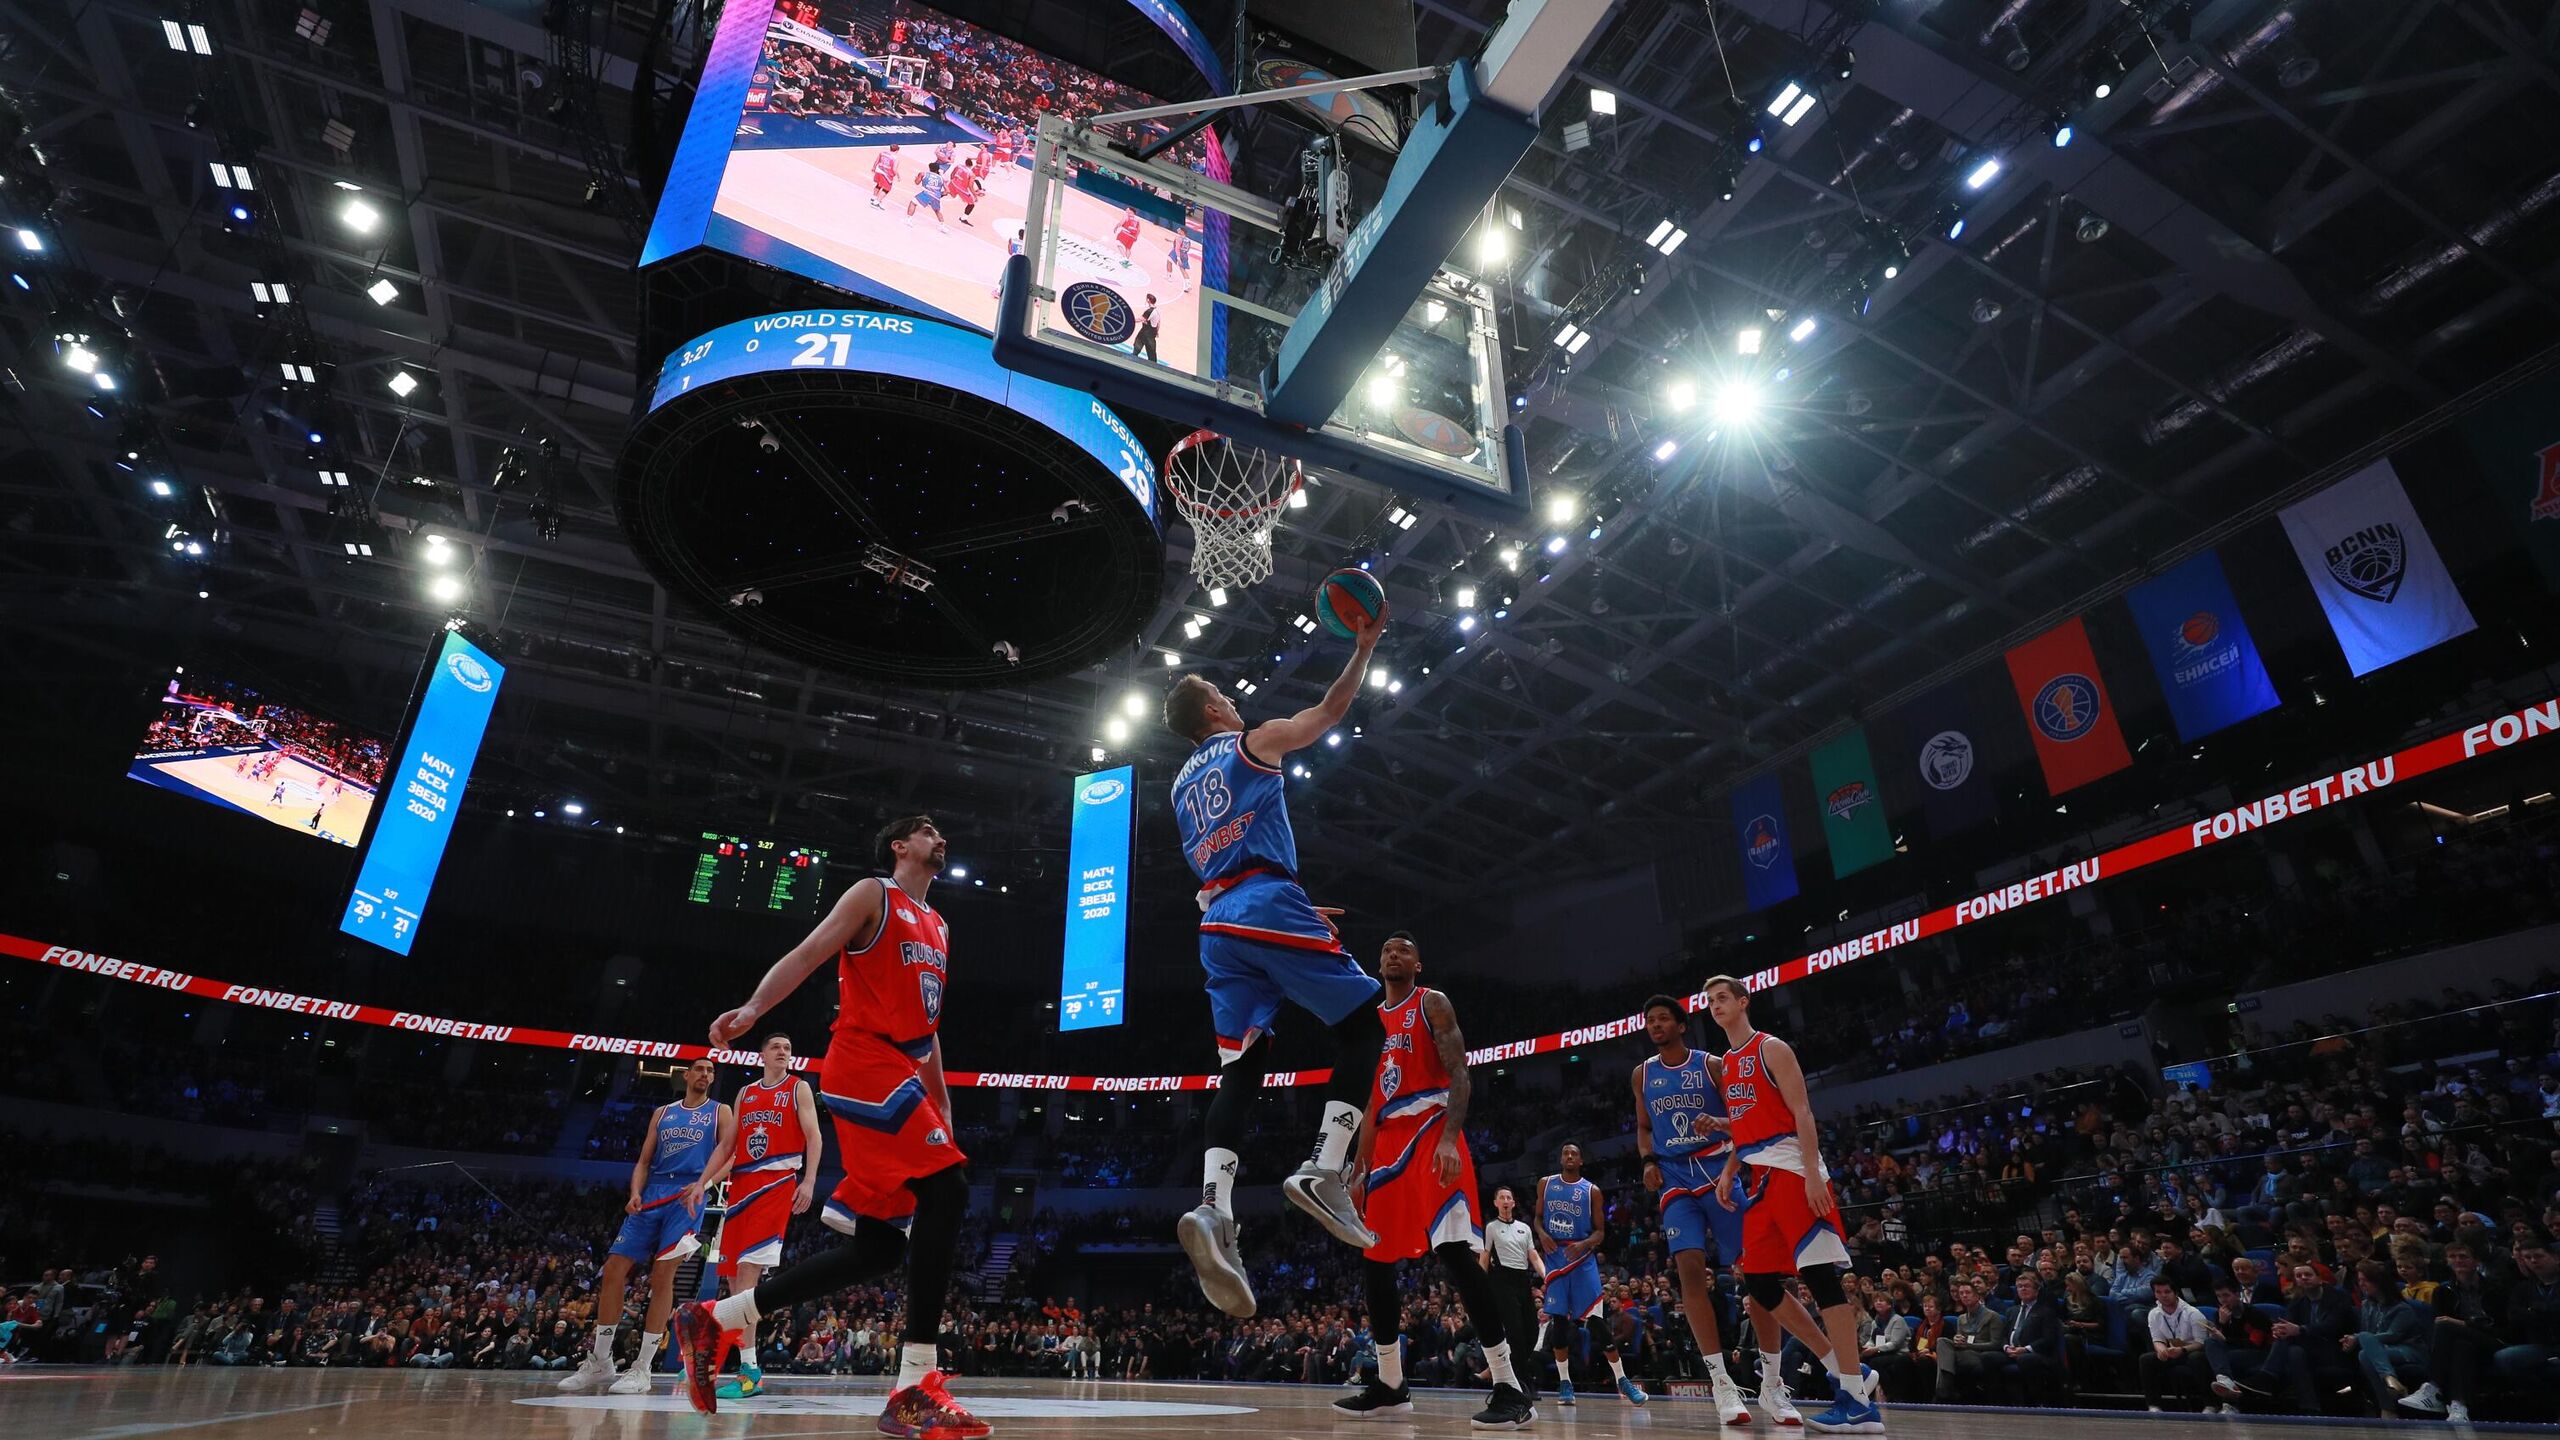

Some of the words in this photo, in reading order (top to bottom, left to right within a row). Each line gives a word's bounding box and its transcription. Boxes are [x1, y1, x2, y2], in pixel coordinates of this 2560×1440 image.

[754, 313, 836, 333] WORLD
[840, 314, 914, 334] STARS
[680, 340, 714, 367] 3:27
[791, 333, 852, 367] 21
[681, 375, 690, 391] 1
[1091, 401, 1144, 462] RUSSIAN
[1120, 450, 1150, 506] 29
[2324, 522, 2399, 567] BCNN
[2174, 642, 2240, 683] ЕНИСЕЙ
[421, 751, 455, 779] МАТЧ
[417, 767, 449, 793] ВСЕХ
[407, 780, 446, 811] ЗВЕЗД
[1186, 767, 1231, 834] 18
[2193, 755, 2395, 848] FONBET.RU
[406, 799, 437, 823] 2020
[757, 840, 775, 850] 3:27
[1194, 810, 1256, 871] FONBET
[795, 855, 809, 868] 21
[1082, 866, 1115, 881] МАТЧ
[1083, 879, 1113, 894] ВСЕХ
[1956, 856, 2100, 926] FONBET.RU
[354, 899, 374, 917] 29
[1079, 892, 1116, 908] ЗВЕЗД
[1082, 906, 1110, 920] 2020
[393, 916, 410, 933] 21
[1807, 918, 1920, 975] FONBET.RU
[40, 945, 193, 991] FONBET.RU
[222, 985, 361, 1020] FONBET.RU
[1066, 1000, 1082, 1014] 29
[1102, 996, 1116, 1009] 21
[389, 1011, 513, 1042] FONBET.RU
[1403, 1008, 1416, 1028] 3
[1560, 1012, 1646, 1049] FONBET.RU
[568, 1033, 681, 1059] FONBET.RU
[1465, 1038, 1536, 1067] ONBET.RU
[1738, 1055, 1756, 1078] 13
[976, 1072, 1069, 1090] FONBET.RU
[1092, 1076, 1182, 1091] FONBET.RU
[1681, 1069, 1703, 1089] 21
[774, 1091, 790, 1108] 11
[1726, 1082, 1757, 1102] SSIA
[1651, 1093, 1705, 1116] WORLD
[689, 1111, 712, 1126] 34
[741, 1109, 783, 1129] RUSSIA
[661, 1126, 704, 1142] WORLD
[750, 1137, 767, 1146] CSKA
[1665, 1135, 1709, 1147] ASTANA
[1572, 1188, 1583, 1201] 3
[1547, 1199, 1582, 1217] WORLD
